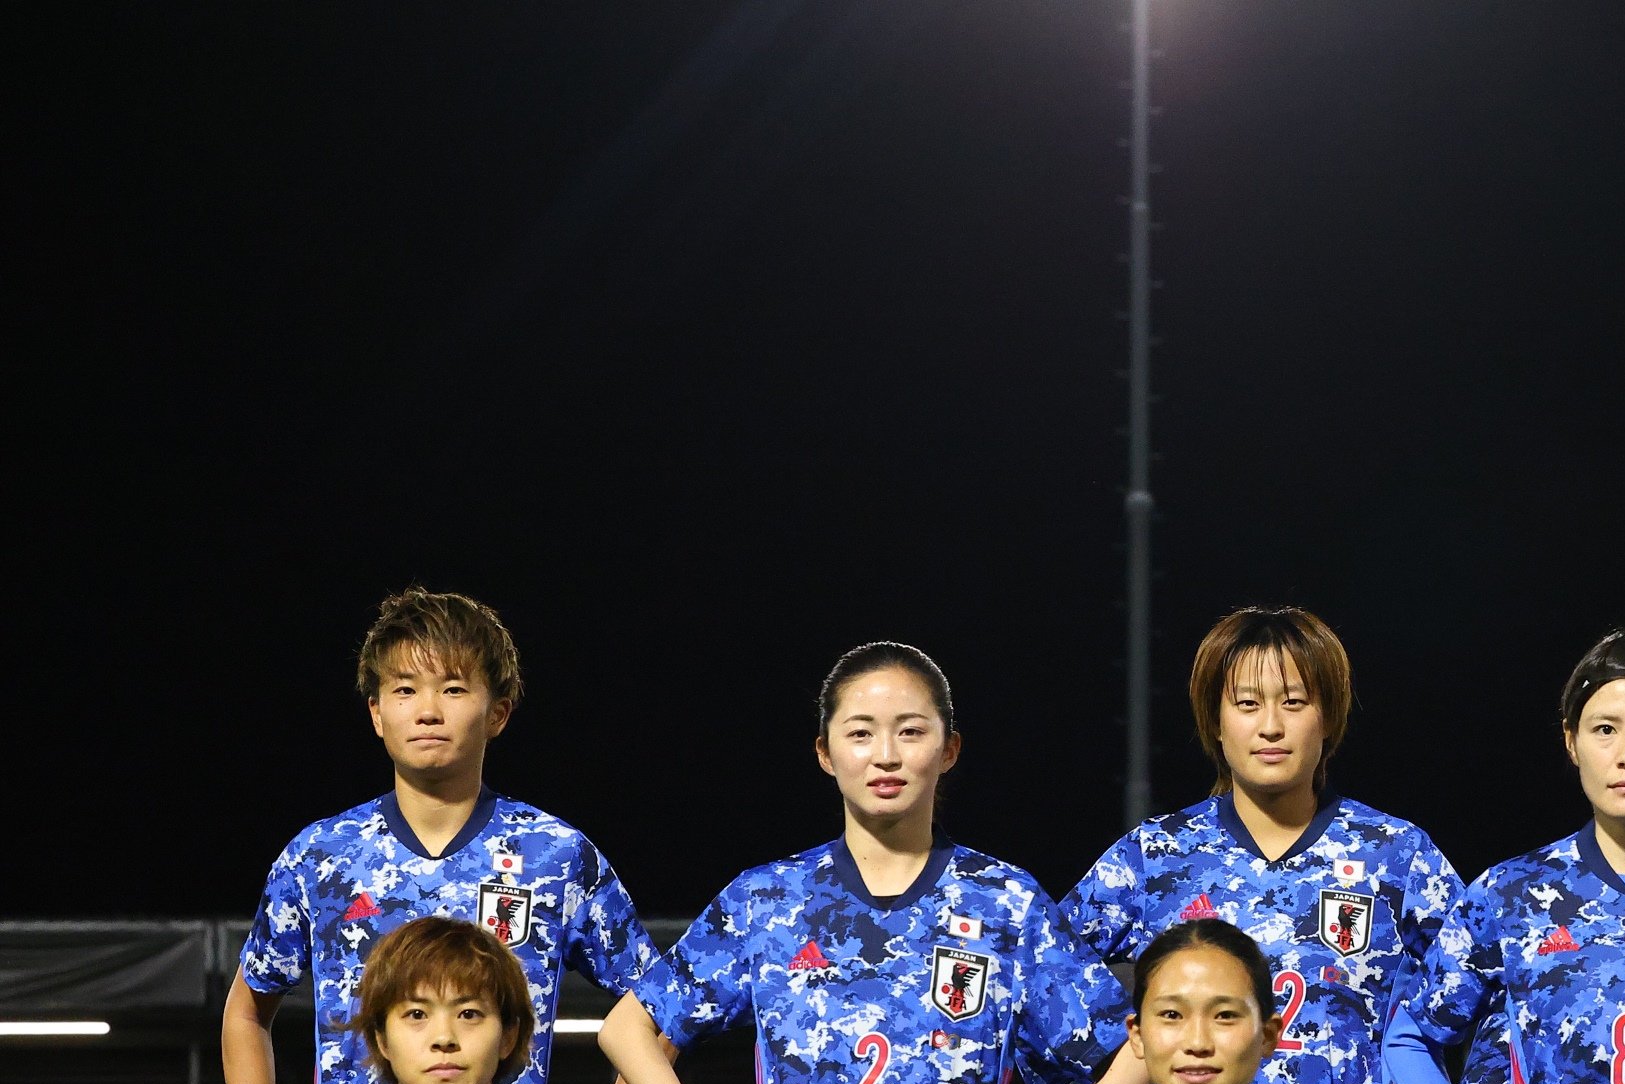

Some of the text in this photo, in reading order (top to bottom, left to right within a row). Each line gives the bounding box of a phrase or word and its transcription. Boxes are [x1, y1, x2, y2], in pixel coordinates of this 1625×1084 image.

[492, 886, 520, 896] JAPAN
[1333, 893, 1361, 903] JAPAN
[948, 950, 977, 962] JAPAN
